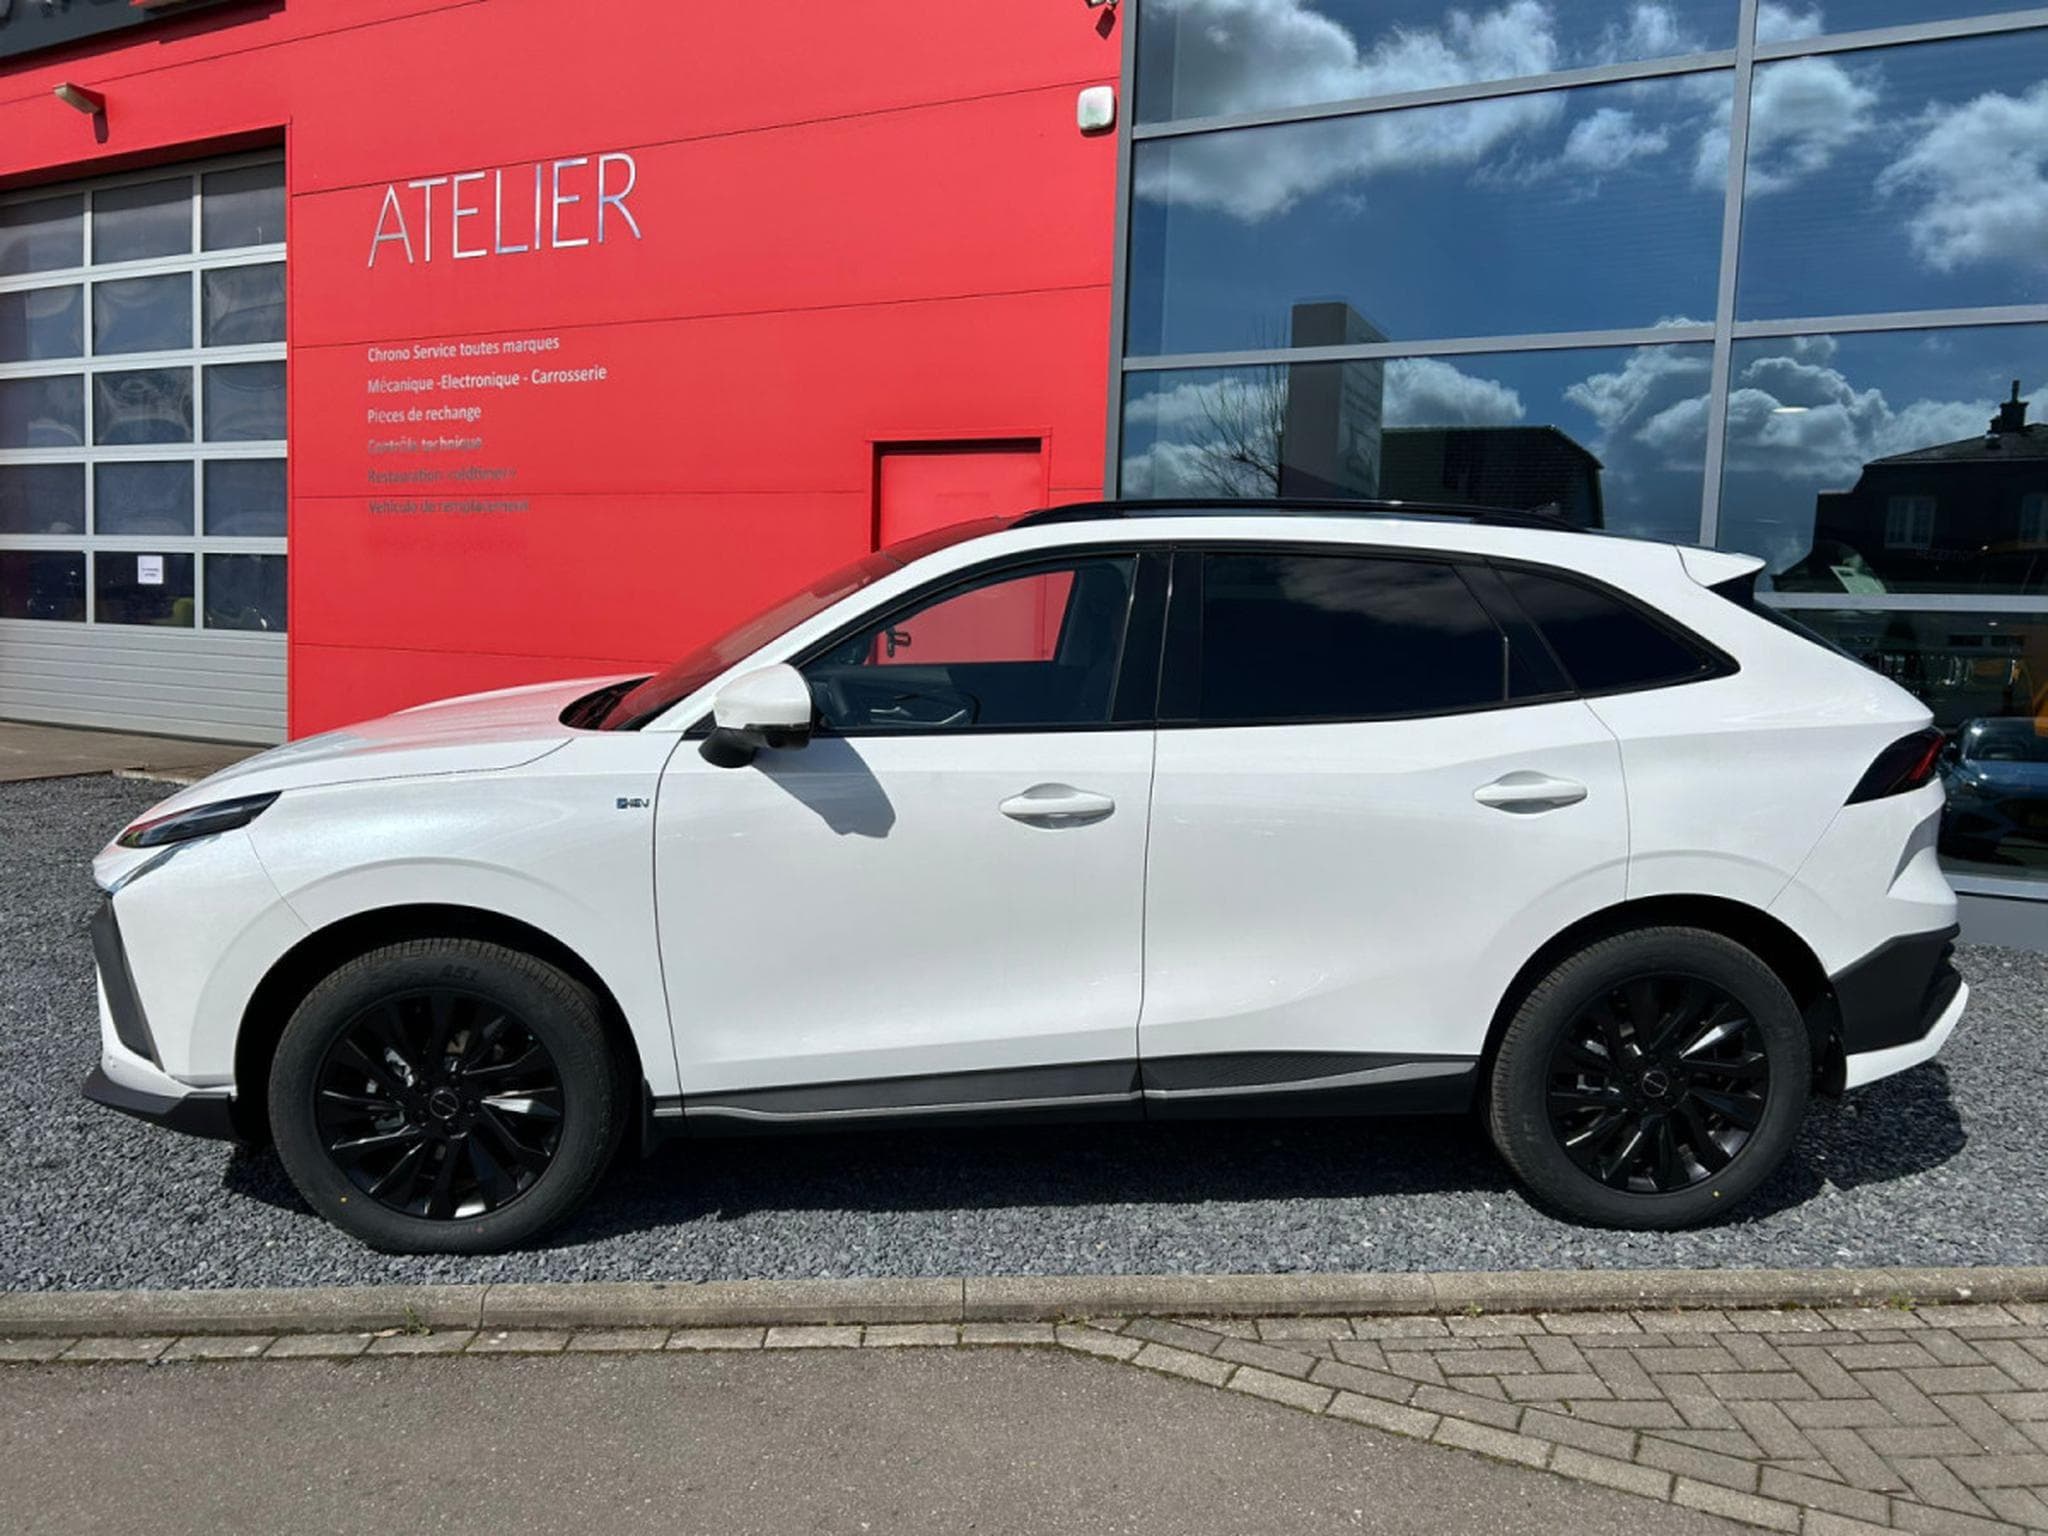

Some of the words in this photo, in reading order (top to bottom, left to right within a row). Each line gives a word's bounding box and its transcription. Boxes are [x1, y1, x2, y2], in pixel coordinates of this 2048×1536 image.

[368, 152, 642, 268] ATELIER
[368, 347, 410, 363] Chrono
[413, 343, 458, 360] Service
[460, 340, 500, 356] toutes
[502, 336, 561, 354] marques
[531, 363, 608, 385] Carrosserie
[407, 405, 423, 422] de
[426, 403, 482, 423] rechange
